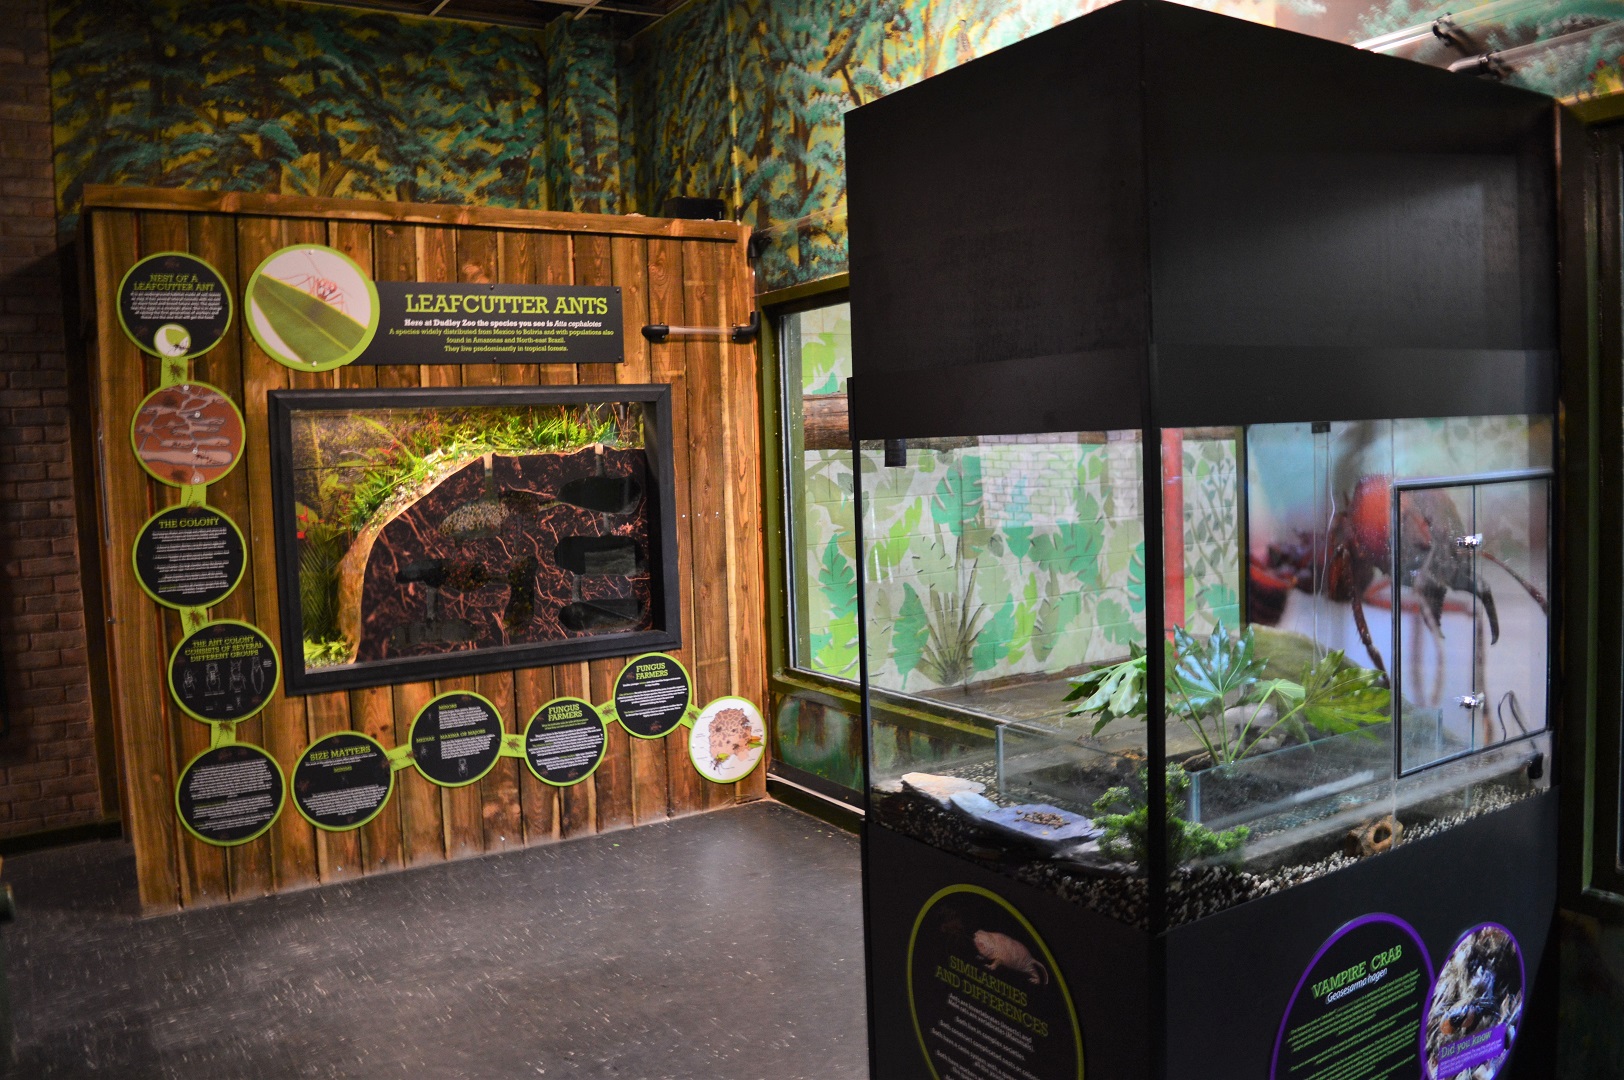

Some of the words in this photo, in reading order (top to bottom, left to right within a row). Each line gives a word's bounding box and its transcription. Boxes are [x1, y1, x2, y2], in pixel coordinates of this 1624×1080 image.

[149, 273, 173, 282] NEST
[175, 274, 189, 283] OF
[190, 274, 198, 283] A
[133, 282, 193, 291] LEAFCUTTER
[195, 283, 215, 291] ANT
[404, 293, 550, 314] LEAFCUTTER
[553, 297, 608, 315] ANTS
[404, 318, 424, 327] Here
[424, 319, 432, 327] at
[433, 318, 461, 328] Dudley
[462, 319, 476, 327] Zoo
[477, 319, 489, 327] the
[490, 319, 517, 328] species
[518, 320, 532, 329] you
[546, 319, 553, 327] is
[568, 320, 602, 329] cephalotes
[389, 327, 395, 335] A
[395, 328, 420, 336] species
[421, 328, 442, 336] widely
[569, 329, 602, 337] populations
[446, 336, 465, 344] found
[473, 336, 504, 344] Amazonas
[443, 345, 460, 353] They
[473, 345, 517, 353] predominantly
[524, 345, 547, 353] tropical
[159, 520, 178, 529] THE
[179, 517, 220, 528] COLONY
[193, 640, 207, 648] THE
[208, 638, 223, 646] ANT
[224, 635, 255, 645] COLONY
[231, 641, 263, 651] SEVERAL
[190, 652, 229, 663] DIFFERENT
[230, 649, 259, 658] GROUPS
[635, 662, 666, 673] FUNGUS
[636, 669, 669, 680] FARMERS
[548, 703, 580, 715] FUNGUS
[548, 710, 583, 722] FARMERS
[310, 751, 330, 762] SIZE
[331, 744, 371, 760] MATTERS
[1311, 961, 1367, 999] VAMPIRE
[1370, 944, 1403, 972] CRAB
[949, 954, 1028, 1007] SIMILARITIES
[1325, 979, 1368, 1005] Geosesarma
[1367, 967, 1389, 984] hagen
[935, 965, 961, 988] AND
[964, 979, 1049, 1037] DIFFERENCES
[1441, 1040, 1456, 1058] Did
[1457, 1036, 1471, 1054] you
[1472, 1030, 1492, 1047] know
